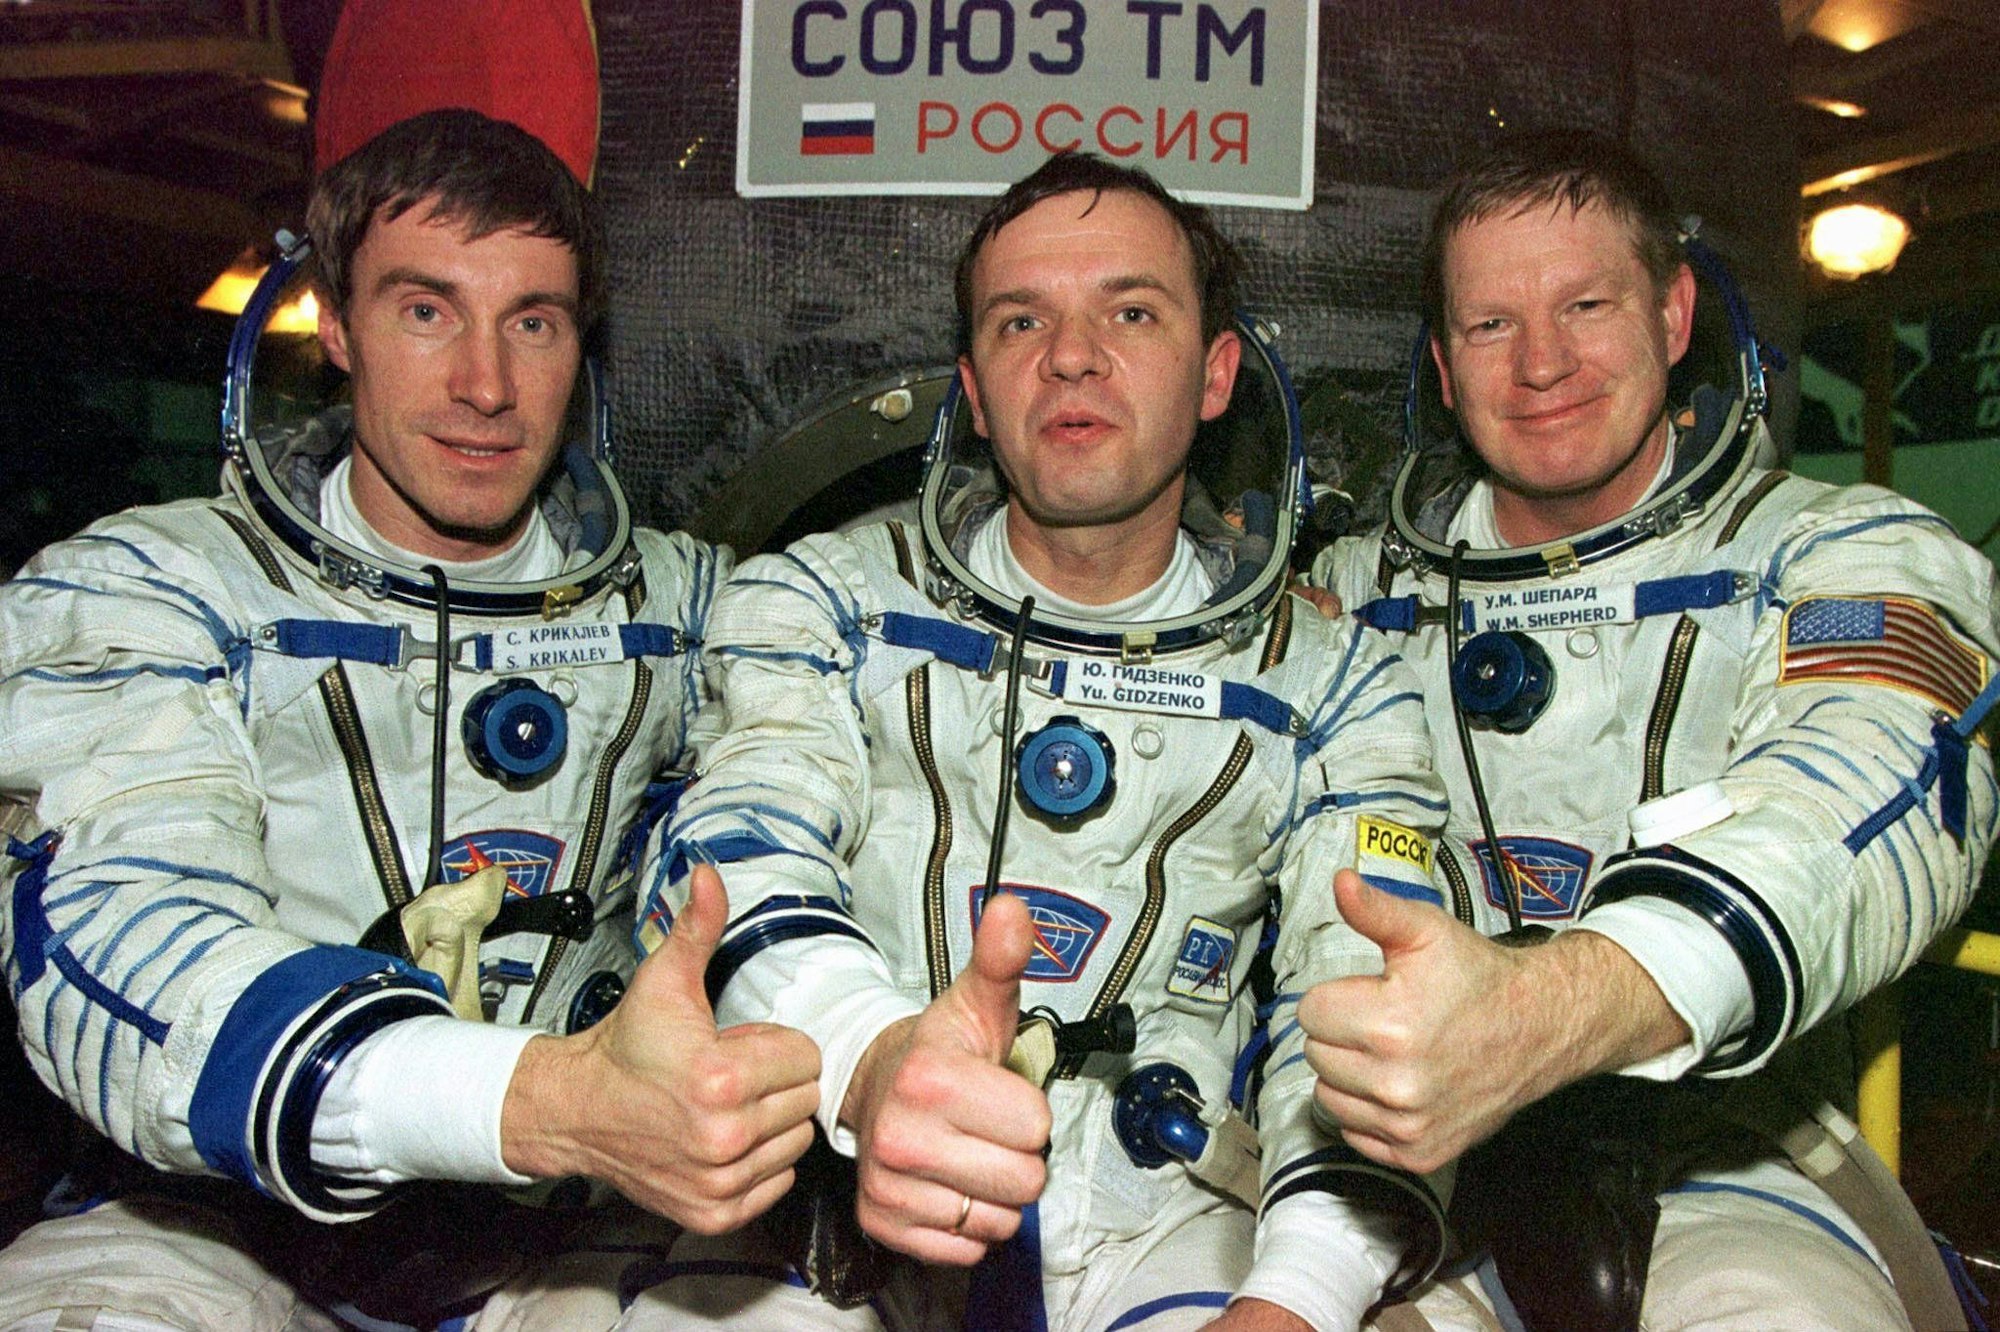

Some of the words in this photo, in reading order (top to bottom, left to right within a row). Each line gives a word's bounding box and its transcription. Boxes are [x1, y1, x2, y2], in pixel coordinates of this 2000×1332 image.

[791, 0, 1087, 77] СОЮЗ
[1127, 2, 1266, 86] ТМ
[917, 101, 1250, 165] РОССИЯ
[1522, 586, 1598, 606] ШЕПАРД
[1528, 606, 1617, 628] SHEPHERD
[506, 631, 522, 646] С.
[529, 625, 611, 644] КРИКАЛЕВ
[506, 655, 521, 670] S.
[529, 647, 608, 667] KRIKALEV
[1082, 662, 1107, 678] Ю.
[1112, 665, 1206, 689] ГИДЗЕНКО
[1081, 684, 1107, 700] Yu.
[1112, 687, 1206, 710] GIDZENKO
